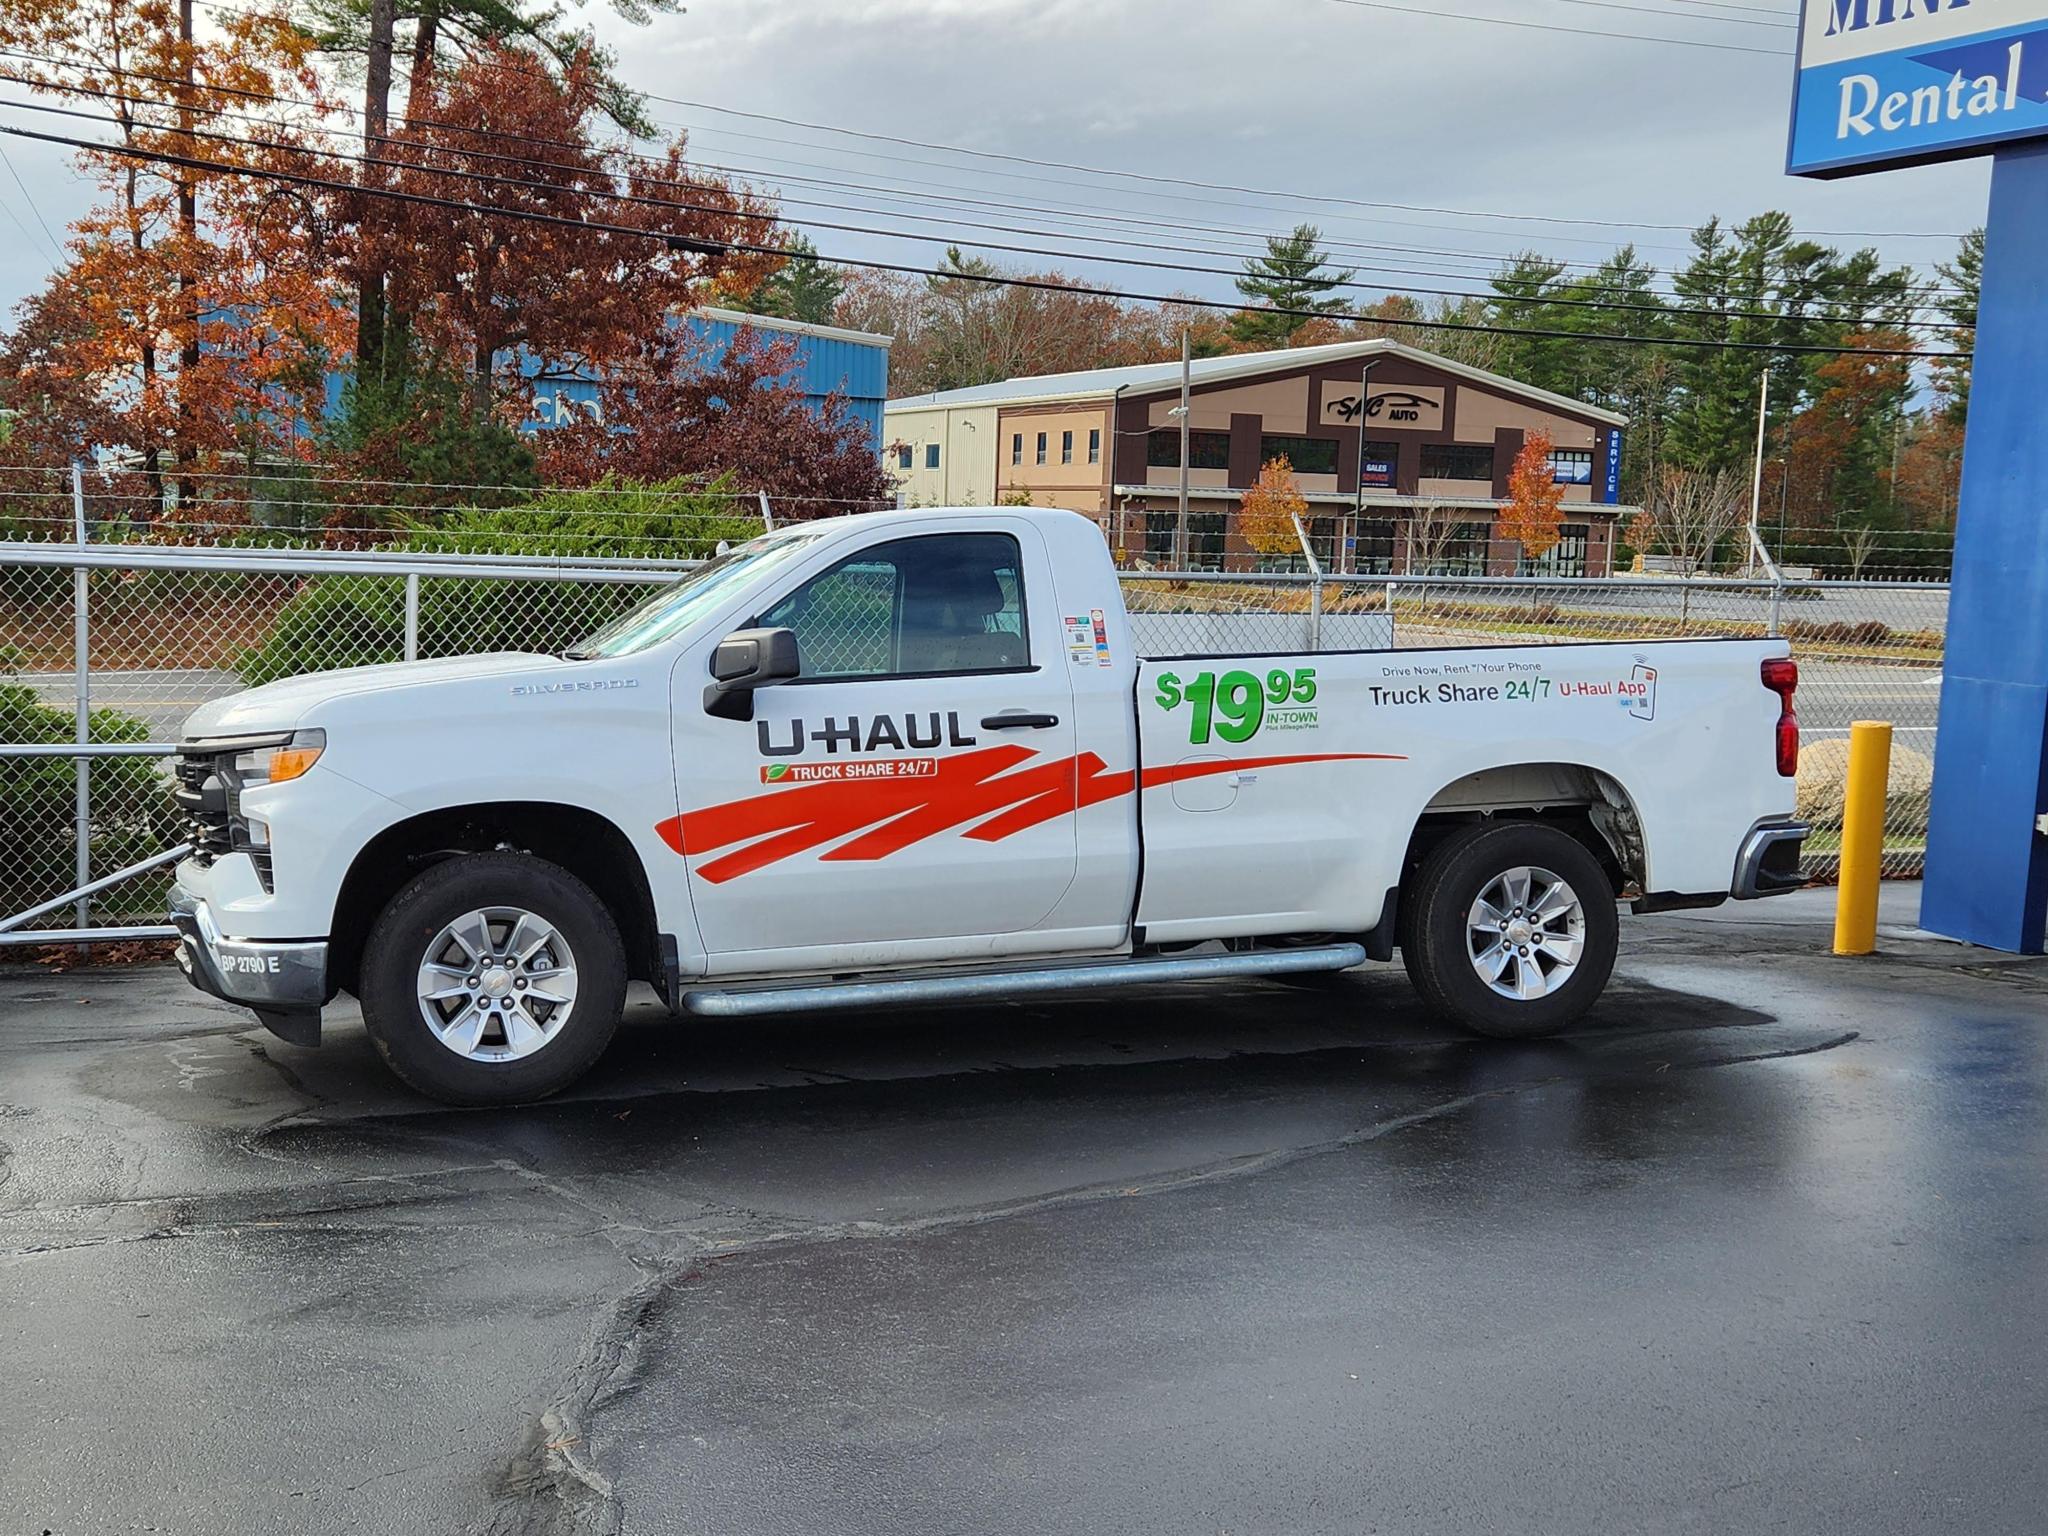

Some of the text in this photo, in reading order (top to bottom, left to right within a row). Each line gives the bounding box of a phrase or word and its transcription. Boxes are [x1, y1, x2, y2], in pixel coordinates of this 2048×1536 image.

[1836, 41, 2023, 139] Rental
[1388, 409, 1419, 421] AUTO
[1366, 463, 1387, 472] SALES
[1607, 430, 1619, 492] SERVICE
[1382, 667, 1411, 677] Drive
[1414, 665, 1441, 676] Now,
[1444, 664, 1470, 674] Rent
[1508, 662, 1541, 672] Phone
[511, 678, 639, 696] SILVERADO
[1368, 676, 1646, 706] Truck Share 24/7 U-Haul App
[1266, 711, 1318, 723] IN-TOWN
[791, 759, 930, 780] TRUCK SHARE 24/7
[221, 955, 281, 973] BP 2790 E
